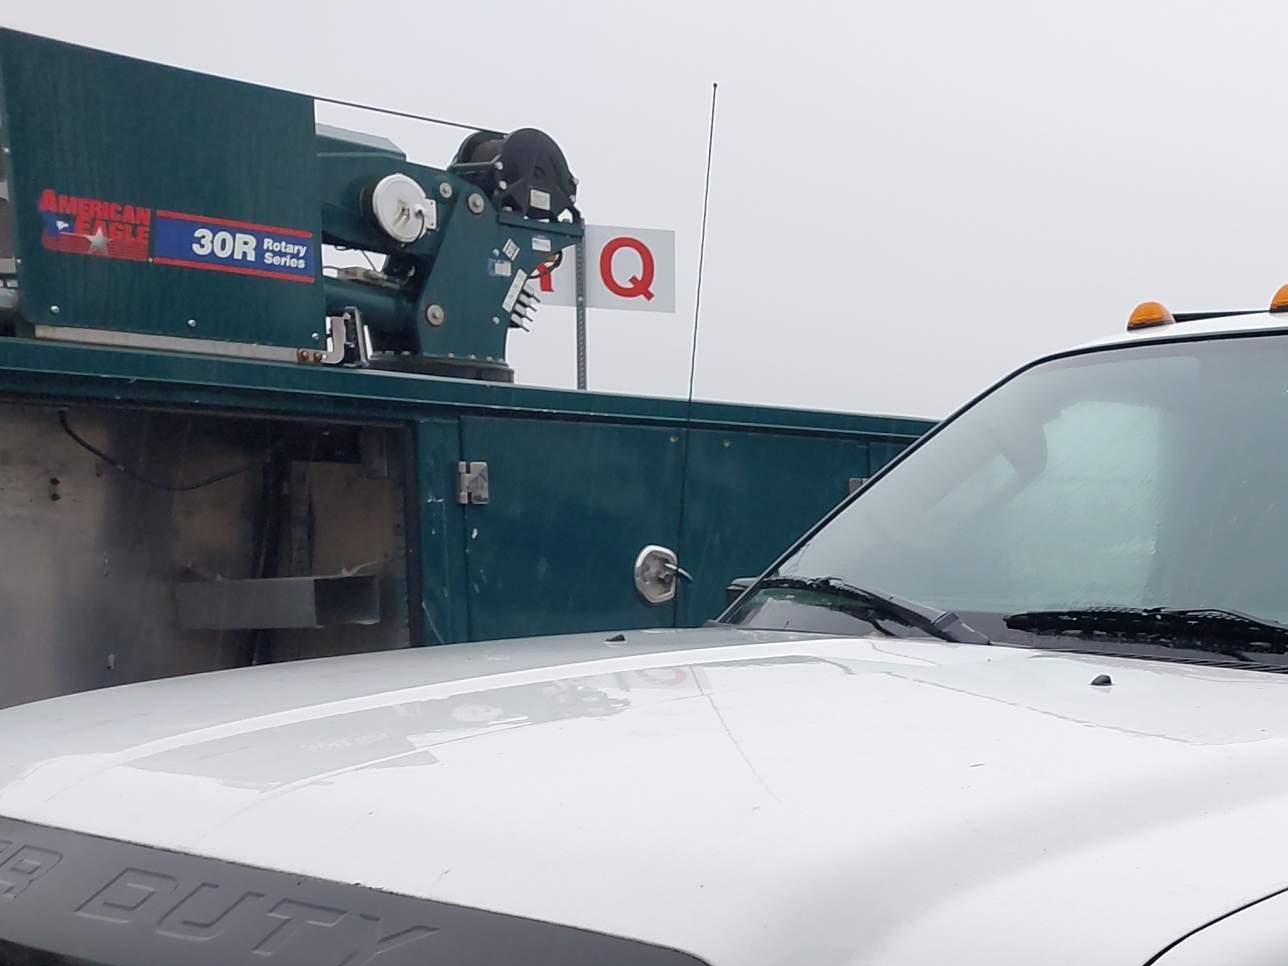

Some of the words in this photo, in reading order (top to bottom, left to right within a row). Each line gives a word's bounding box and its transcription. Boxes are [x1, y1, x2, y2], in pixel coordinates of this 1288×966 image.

[38, 187, 151, 226] AMERICAN
[75, 213, 149, 242] EAGLE
[191, 228, 257, 262] 30R
[263, 238, 307, 257] Rotary
[263, 252, 306, 269] Series
[600, 237, 655, 301] Q
